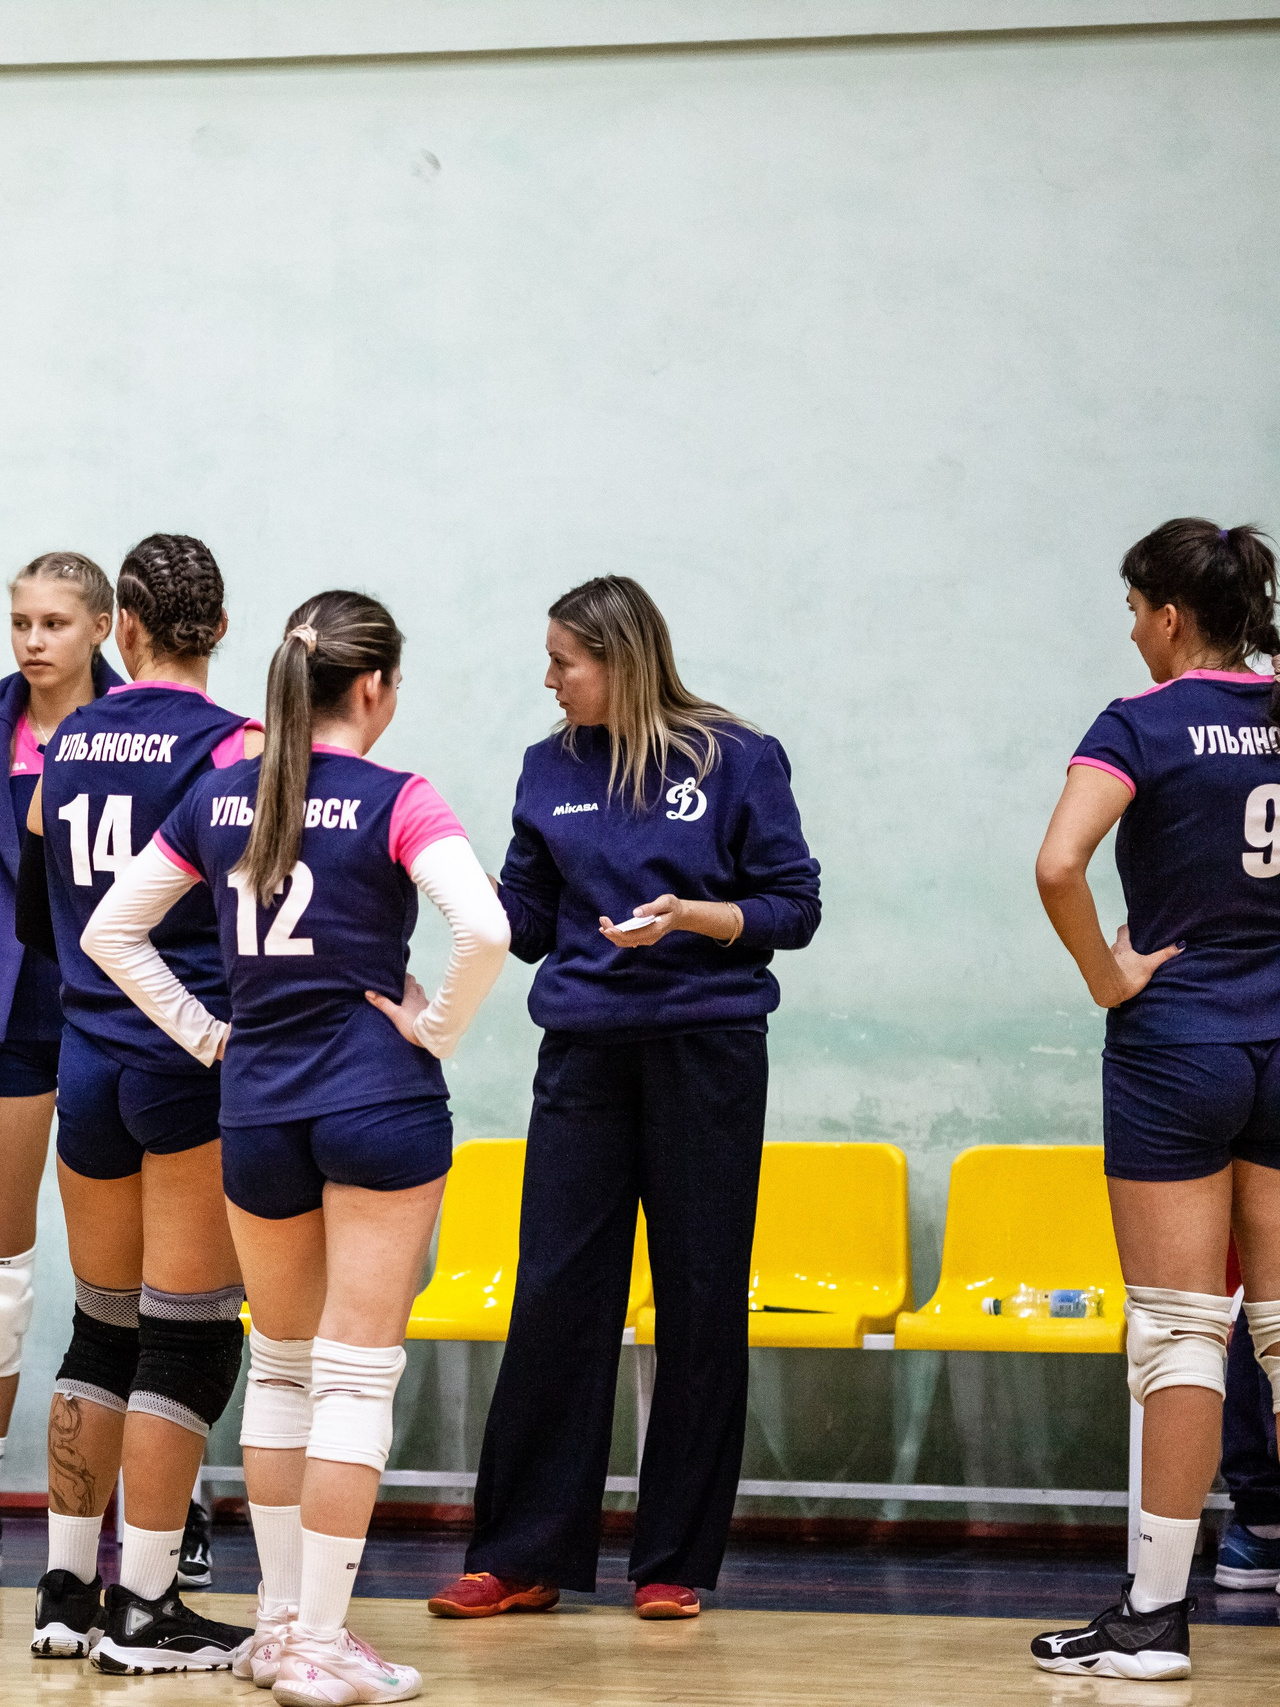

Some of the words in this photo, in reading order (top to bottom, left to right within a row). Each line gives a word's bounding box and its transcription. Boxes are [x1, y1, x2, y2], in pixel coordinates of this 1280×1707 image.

[54, 732, 178, 764] УЛЬЯНОВСК
[1188, 725, 1280, 755] УЛЬЯНО
[58, 794, 134, 886] 14
[210, 796, 361, 829] УЛЬВСК
[1242, 783, 1280, 879] 9
[227, 860, 315, 956] 12
